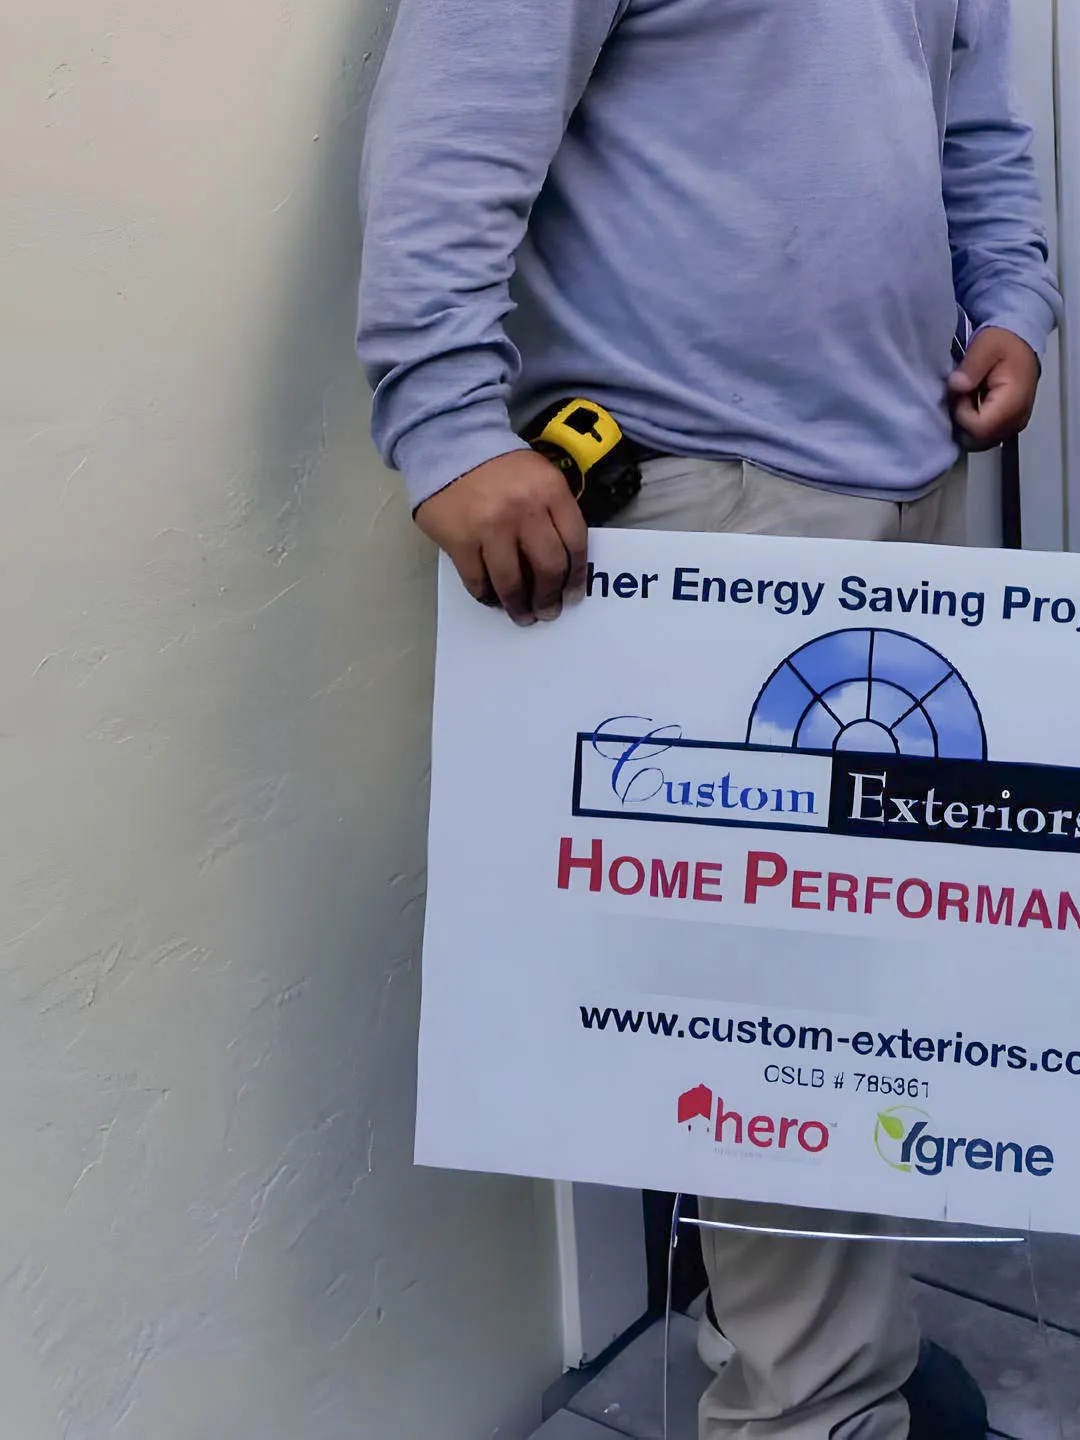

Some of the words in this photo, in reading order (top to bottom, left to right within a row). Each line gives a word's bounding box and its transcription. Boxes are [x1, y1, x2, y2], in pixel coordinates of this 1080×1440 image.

[672, 567, 825, 616] Energy
[838, 575, 986, 627] Saving
[592, 715, 818, 815] Custom
[557, 837, 722, 902] HOME
[763, 1064, 825, 1089] CSLB
[832, 1071, 845, 1090] #
[853, 1072, 931, 1099] 785361
[714, 1096, 830, 1153] hero
[900, 1121, 1054, 1177] Ygrene
